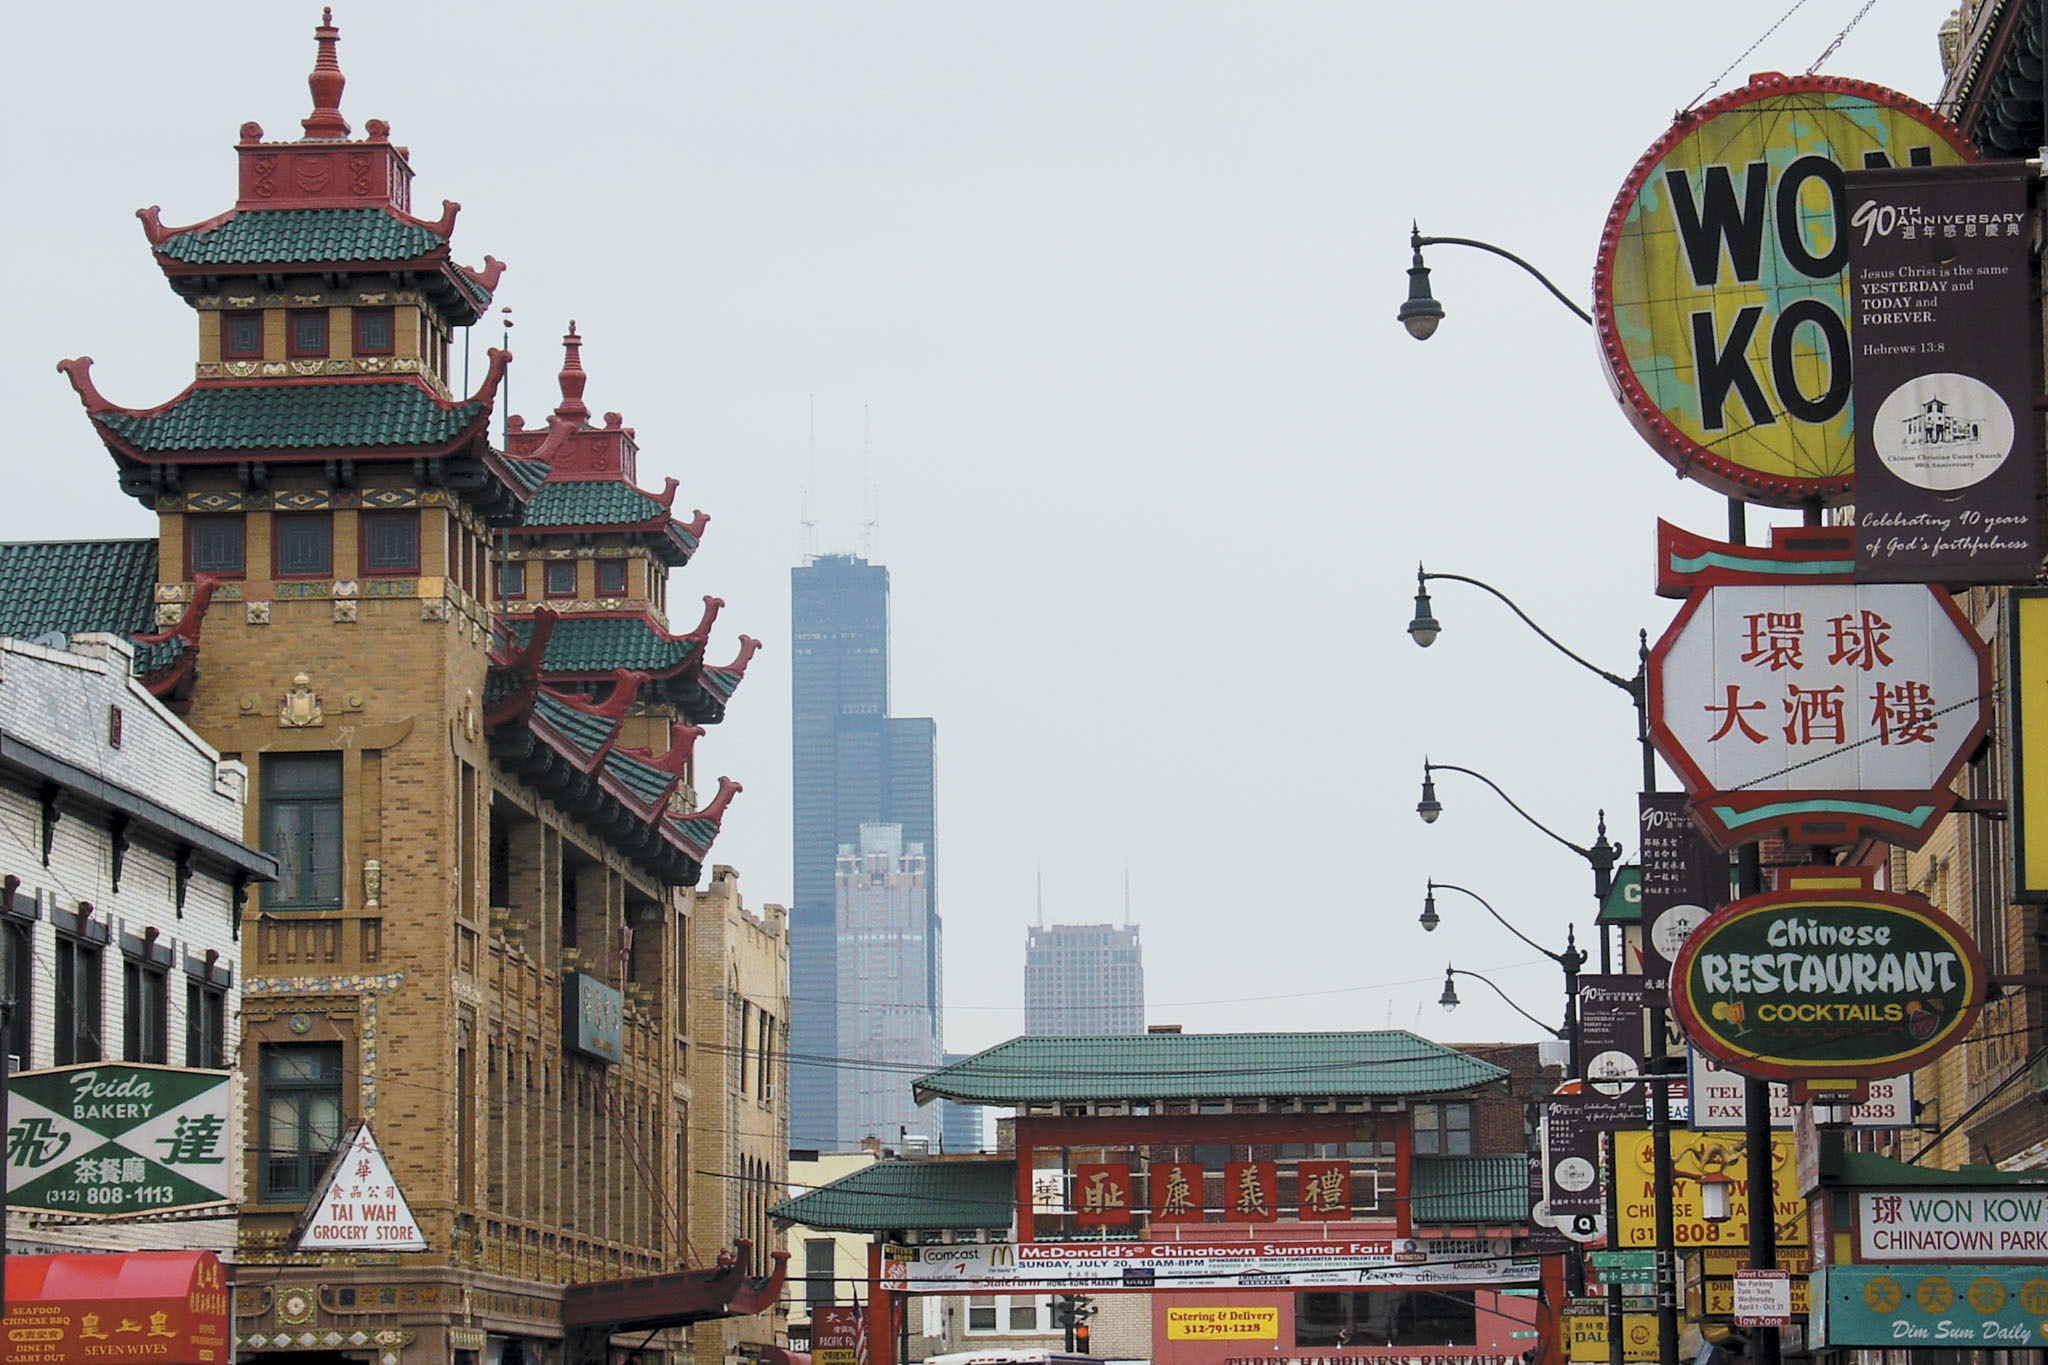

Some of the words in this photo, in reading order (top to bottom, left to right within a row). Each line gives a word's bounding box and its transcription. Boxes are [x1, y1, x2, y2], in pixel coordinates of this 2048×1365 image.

[1666, 147, 1932, 288] WO
[1897, 213, 2024, 226] ANNIVERSARY
[1861, 269, 1894, 280] Jesus
[1899, 266, 1936, 278] Christ
[1940, 267, 1950, 278] is
[1954, 265, 1973, 276] the
[1977, 266, 2008, 276] same
[1862, 281, 1948, 295] YESTERDAY
[1952, 280, 1974, 292] and
[1862, 297, 1912, 310] TODAY
[1916, 296, 1938, 307] and
[1863, 312, 1936, 325] FOREVER.
[1864, 344, 1916, 355] Hebrews
[1921, 343, 1945, 353] 13:8
[1862, 512, 1951, 531] Celebrating
[1960, 510, 1980, 525] 90
[1985, 517, 2028, 533] years
[1866, 538, 1881, 558] of
[1887, 538, 1929, 557] God's
[1931, 535, 2029, 557] faithfulness
[1741, 610, 1893, 671] 環球
[1704, 680, 1939, 746] 大酒樓
[1767, 918, 1892, 947] Chinese
[1701, 951, 1957, 994] RESTAURANT
[1758, 1003, 1903, 1023] COCKTAILS
[70, 1071, 154, 1103] Feida
[1706, 1086, 1743, 1099] TEL
[73, 1103, 153, 1120] BAKERY
[1708, 1105, 1743, 1117] FAX
[74, 1157, 146, 1184] 茶餐廳
[46, 1190, 80, 1204] (312)
[331, 1183, 395, 1200] 食品公司
[331, 1204, 353, 1221] TAI
[362, 1204, 396, 1221] WAH
[1871, 1196, 1903, 1224] 球
[1910, 1199, 1972, 1223] WON
[1984, 1199, 2042, 1222] KOW
[313, 1225, 368, 1240] GROCERY
[376, 1225, 414, 1240] STORE
[1675, 1224, 1719, 1242] 808
[1873, 1230, 1993, 1250] CHINATOWN
[1021, 1245, 1134, 1258] McDonald's
[1151, 1245, 1256, 1257] Chinatown
[1264, 1244, 1344, 1255] Summer
[1350, 1243, 1388, 1254] Fair
[1706, 1249, 1750, 1258] MANDARIN
[1018, 1260, 1072, 1269] SUNDAY,
[1077, 1260, 1108, 1268] JULY
[1114, 1260, 1132, 1269] 20,
[1141, 1259, 1205, 1267] 10AM-8PM
[1416, 1269, 1459, 1283] citibank
[1737, 1271, 1757, 1279] Street
[1758, 1271, 1786, 1280] Cleaning
[1748, 1280, 1773, 1288] Parking
[12, 1306, 61, 1315] SEAFOOD
[1169, 1312, 1216, 1323] Catering
[1230, 1311, 1274, 1322] Delivery
[3, 1317, 46, 1326] CHINESE
[50, 1316, 70, 1326] BBQ
[79, 1311, 178, 1340] 皇上皇
[1183, 1323, 1261, 1334] 312-791-1228
[1739, 1317, 1757, 1325] Tow
[1760, 1317, 1782, 1325] Zone
[1892, 1320, 1929, 1339] Dim
[1935, 1320, 1975, 1339] Sum
[1982, 1321, 2032, 1344] Daily
[16, 1344, 41, 1353] DINE
[44, 1344, 56, 1352] IN
[85, 1345, 125, 1356] SEVEN
[127, 1344, 167, 1355] WIVES
[6, 1354, 41, 1363] CARRY
[44, 1353, 65, 1362] OUT
[1420, 1355, 1520, 1365] RESTAURA
